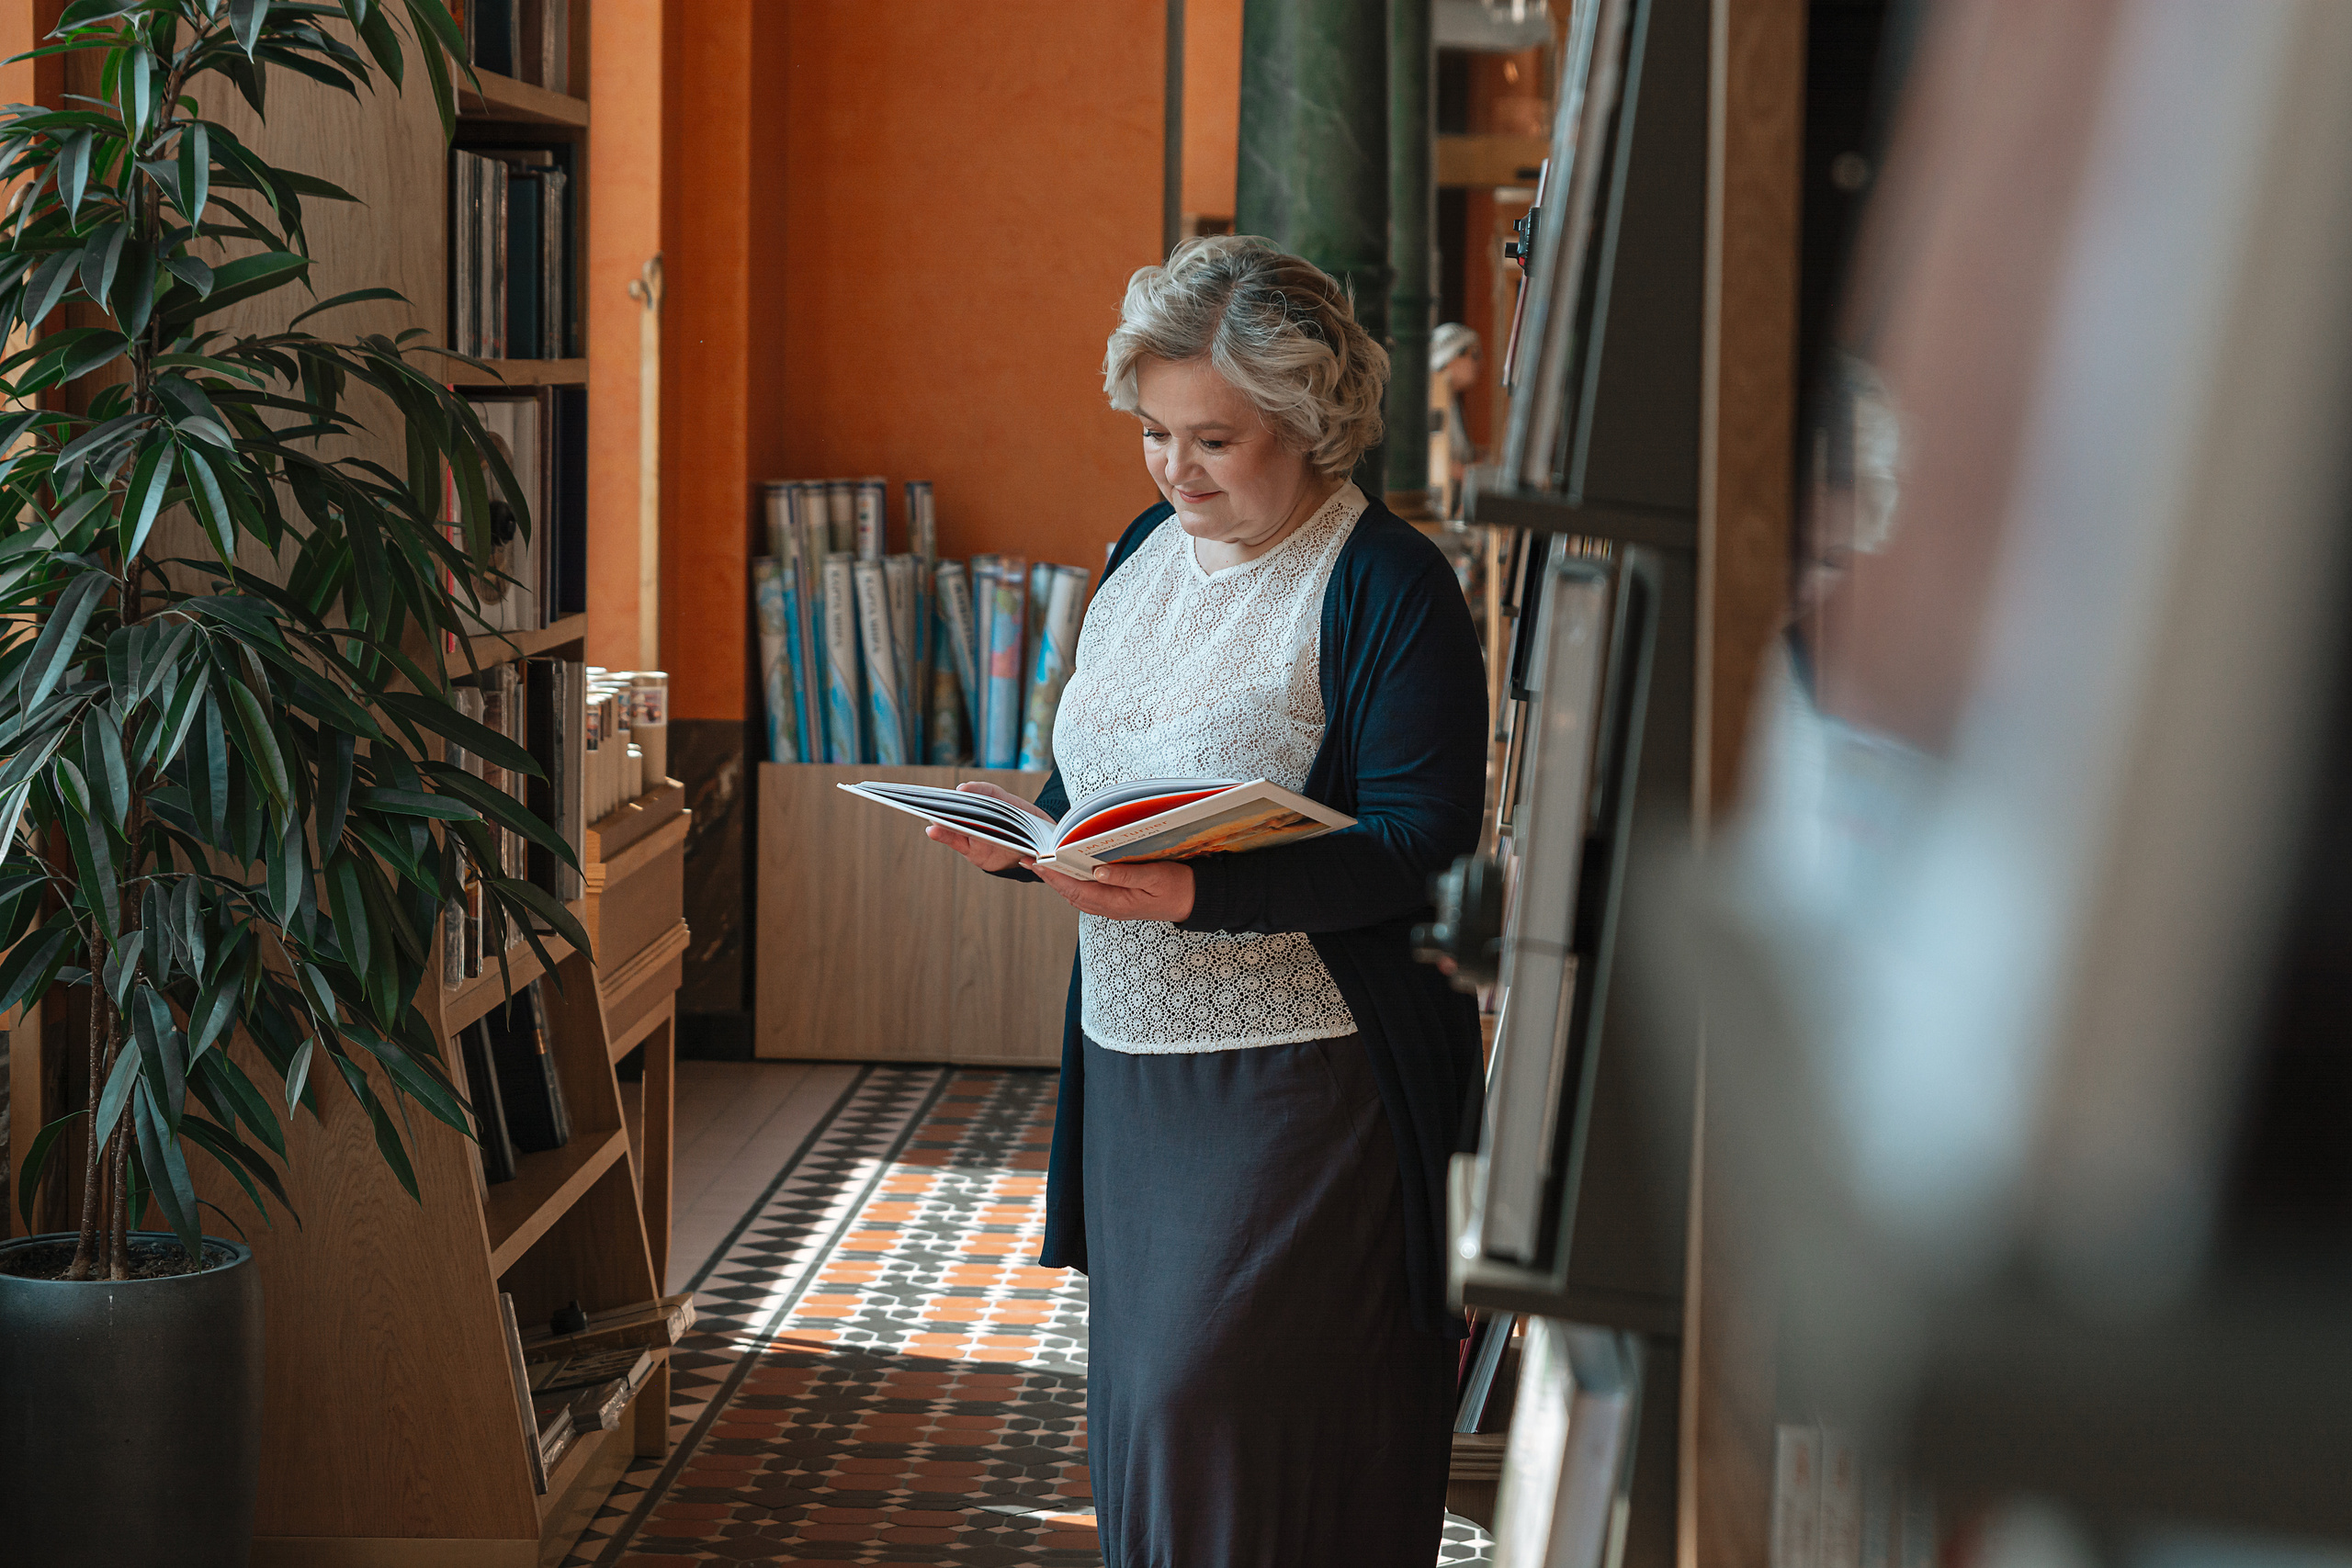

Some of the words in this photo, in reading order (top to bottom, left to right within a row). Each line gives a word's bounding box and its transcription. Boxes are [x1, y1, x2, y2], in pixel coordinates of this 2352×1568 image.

[1078, 838, 1120, 853] J.M.W.
[1121, 820, 1168, 838] Turner
[1085, 837, 1137, 856] Masterpieces
